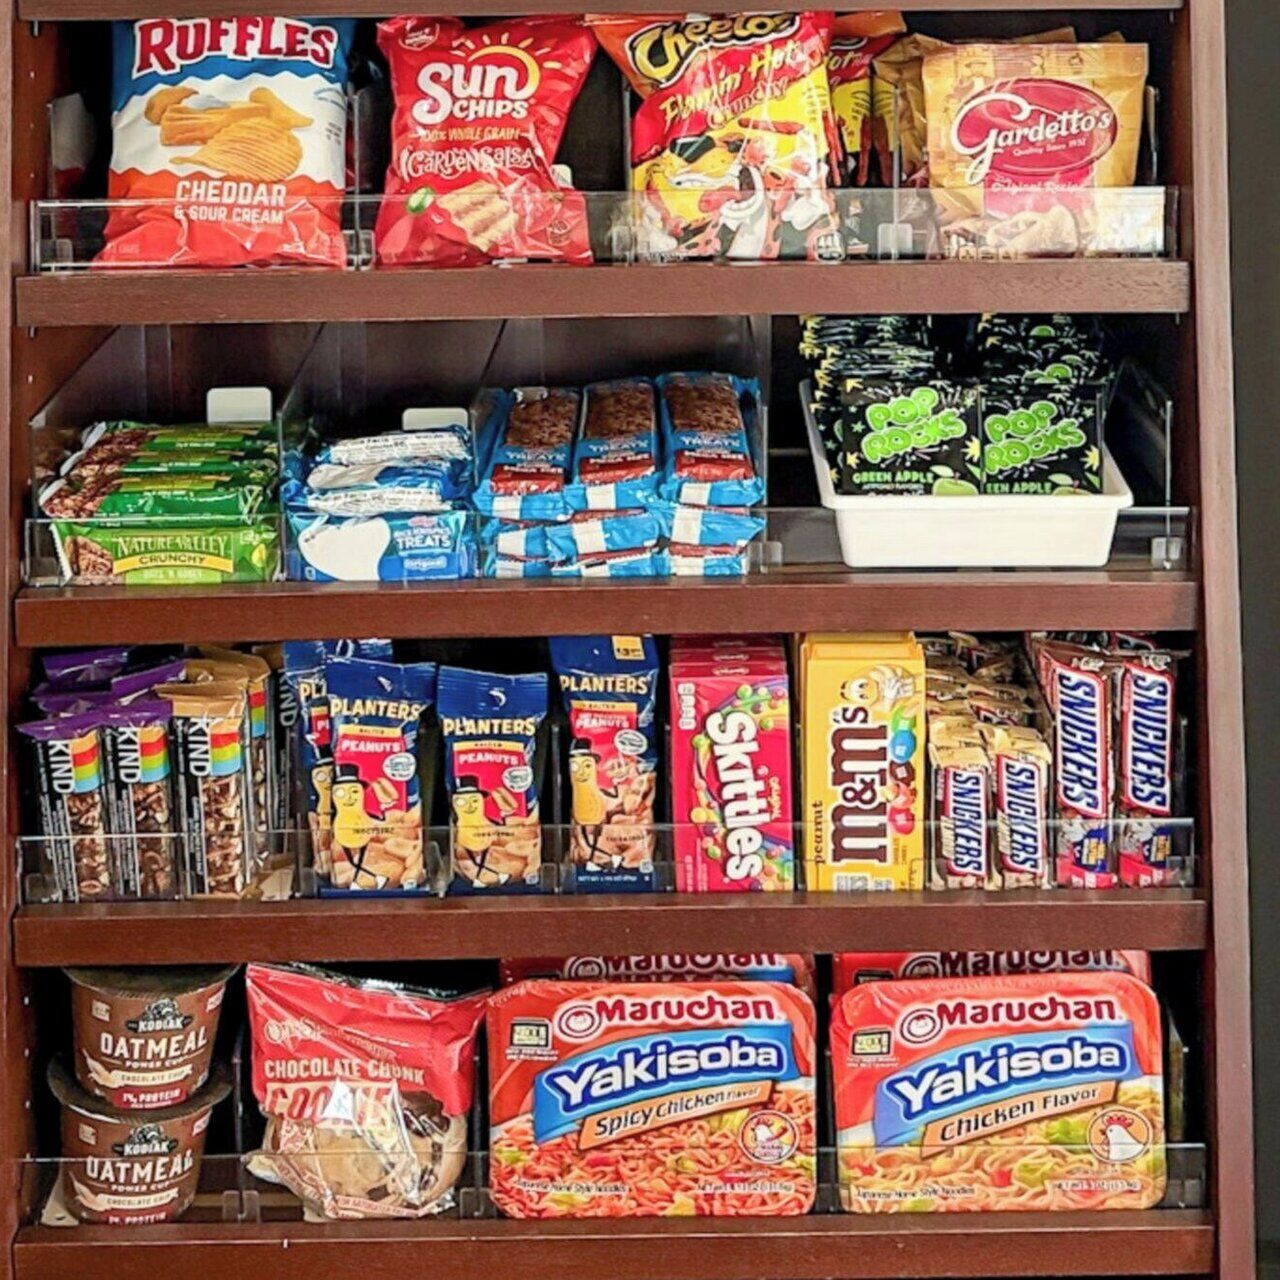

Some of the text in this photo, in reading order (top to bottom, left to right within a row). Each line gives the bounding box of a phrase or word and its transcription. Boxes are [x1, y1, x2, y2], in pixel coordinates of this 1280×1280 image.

[135, 17, 335, 72] RUFFLES
[629, 12, 799, 86] Cheetos
[412, 62, 539, 125] Sun
[453, 99, 529, 119] CHIPS
[951, 91, 1112, 186] Gardetto's
[175, 179, 287, 206] CHEDDAR
[189, 205, 228, 222] SOUR
[232, 206, 284, 224] CREAM
[865, 386, 940, 431] POP
[984, 400, 1058, 445] POP
[861, 407, 968, 464] ROCKS
[852, 470, 935, 485] GREEN APPLE
[1014, 481, 1052, 494] APPLE
[118, 534, 230, 555] NATURE VALLEY
[138, 552, 206, 566] CRUNCHY
[396, 534, 452, 551] TREATS
[559, 674, 649, 695] PLANTERS
[330, 698, 422, 721] PLANTERS
[442, 717, 536, 737] PLANTERS
[575, 714, 630, 729] PEANUTS
[118, 725, 141, 785] KIND
[188, 717, 210, 778] KIND
[340, 738, 402, 754] PEANUTS
[458, 751, 520, 766] PEANUTS
[1058, 673, 1099, 810] SNICKERS
[1130, 673, 1169, 808] SNICKERS
[48, 739, 75, 795] KIND
[831, 705, 888, 864] m&m's
[706, 710, 772, 881] Skittles
[813, 800, 824, 865] peanut
[952, 772, 982, 873] SNICKERS
[1005, 761, 1038, 871] SNICKERS
[137, 1017, 184, 1033] KODIAK
[595, 995, 775, 1022] Maruchan
[936, 995, 1118, 1026] Maruchan
[100, 1026, 208, 1058] OATMEAL
[263, 1058, 425, 1085] CHOCOLATE CHUNK
[554, 1039, 778, 1106] Yakisoba
[895, 1038, 1121, 1115] Yakisoba
[594, 1107, 652, 1138] Spicy
[654, 1090, 726, 1119] Chicken
[940, 1086, 1099, 1142] Chicken Flavor
[123, 1140, 170, 1156] KODIAK
[86, 1153, 194, 1182] OATMEAL
